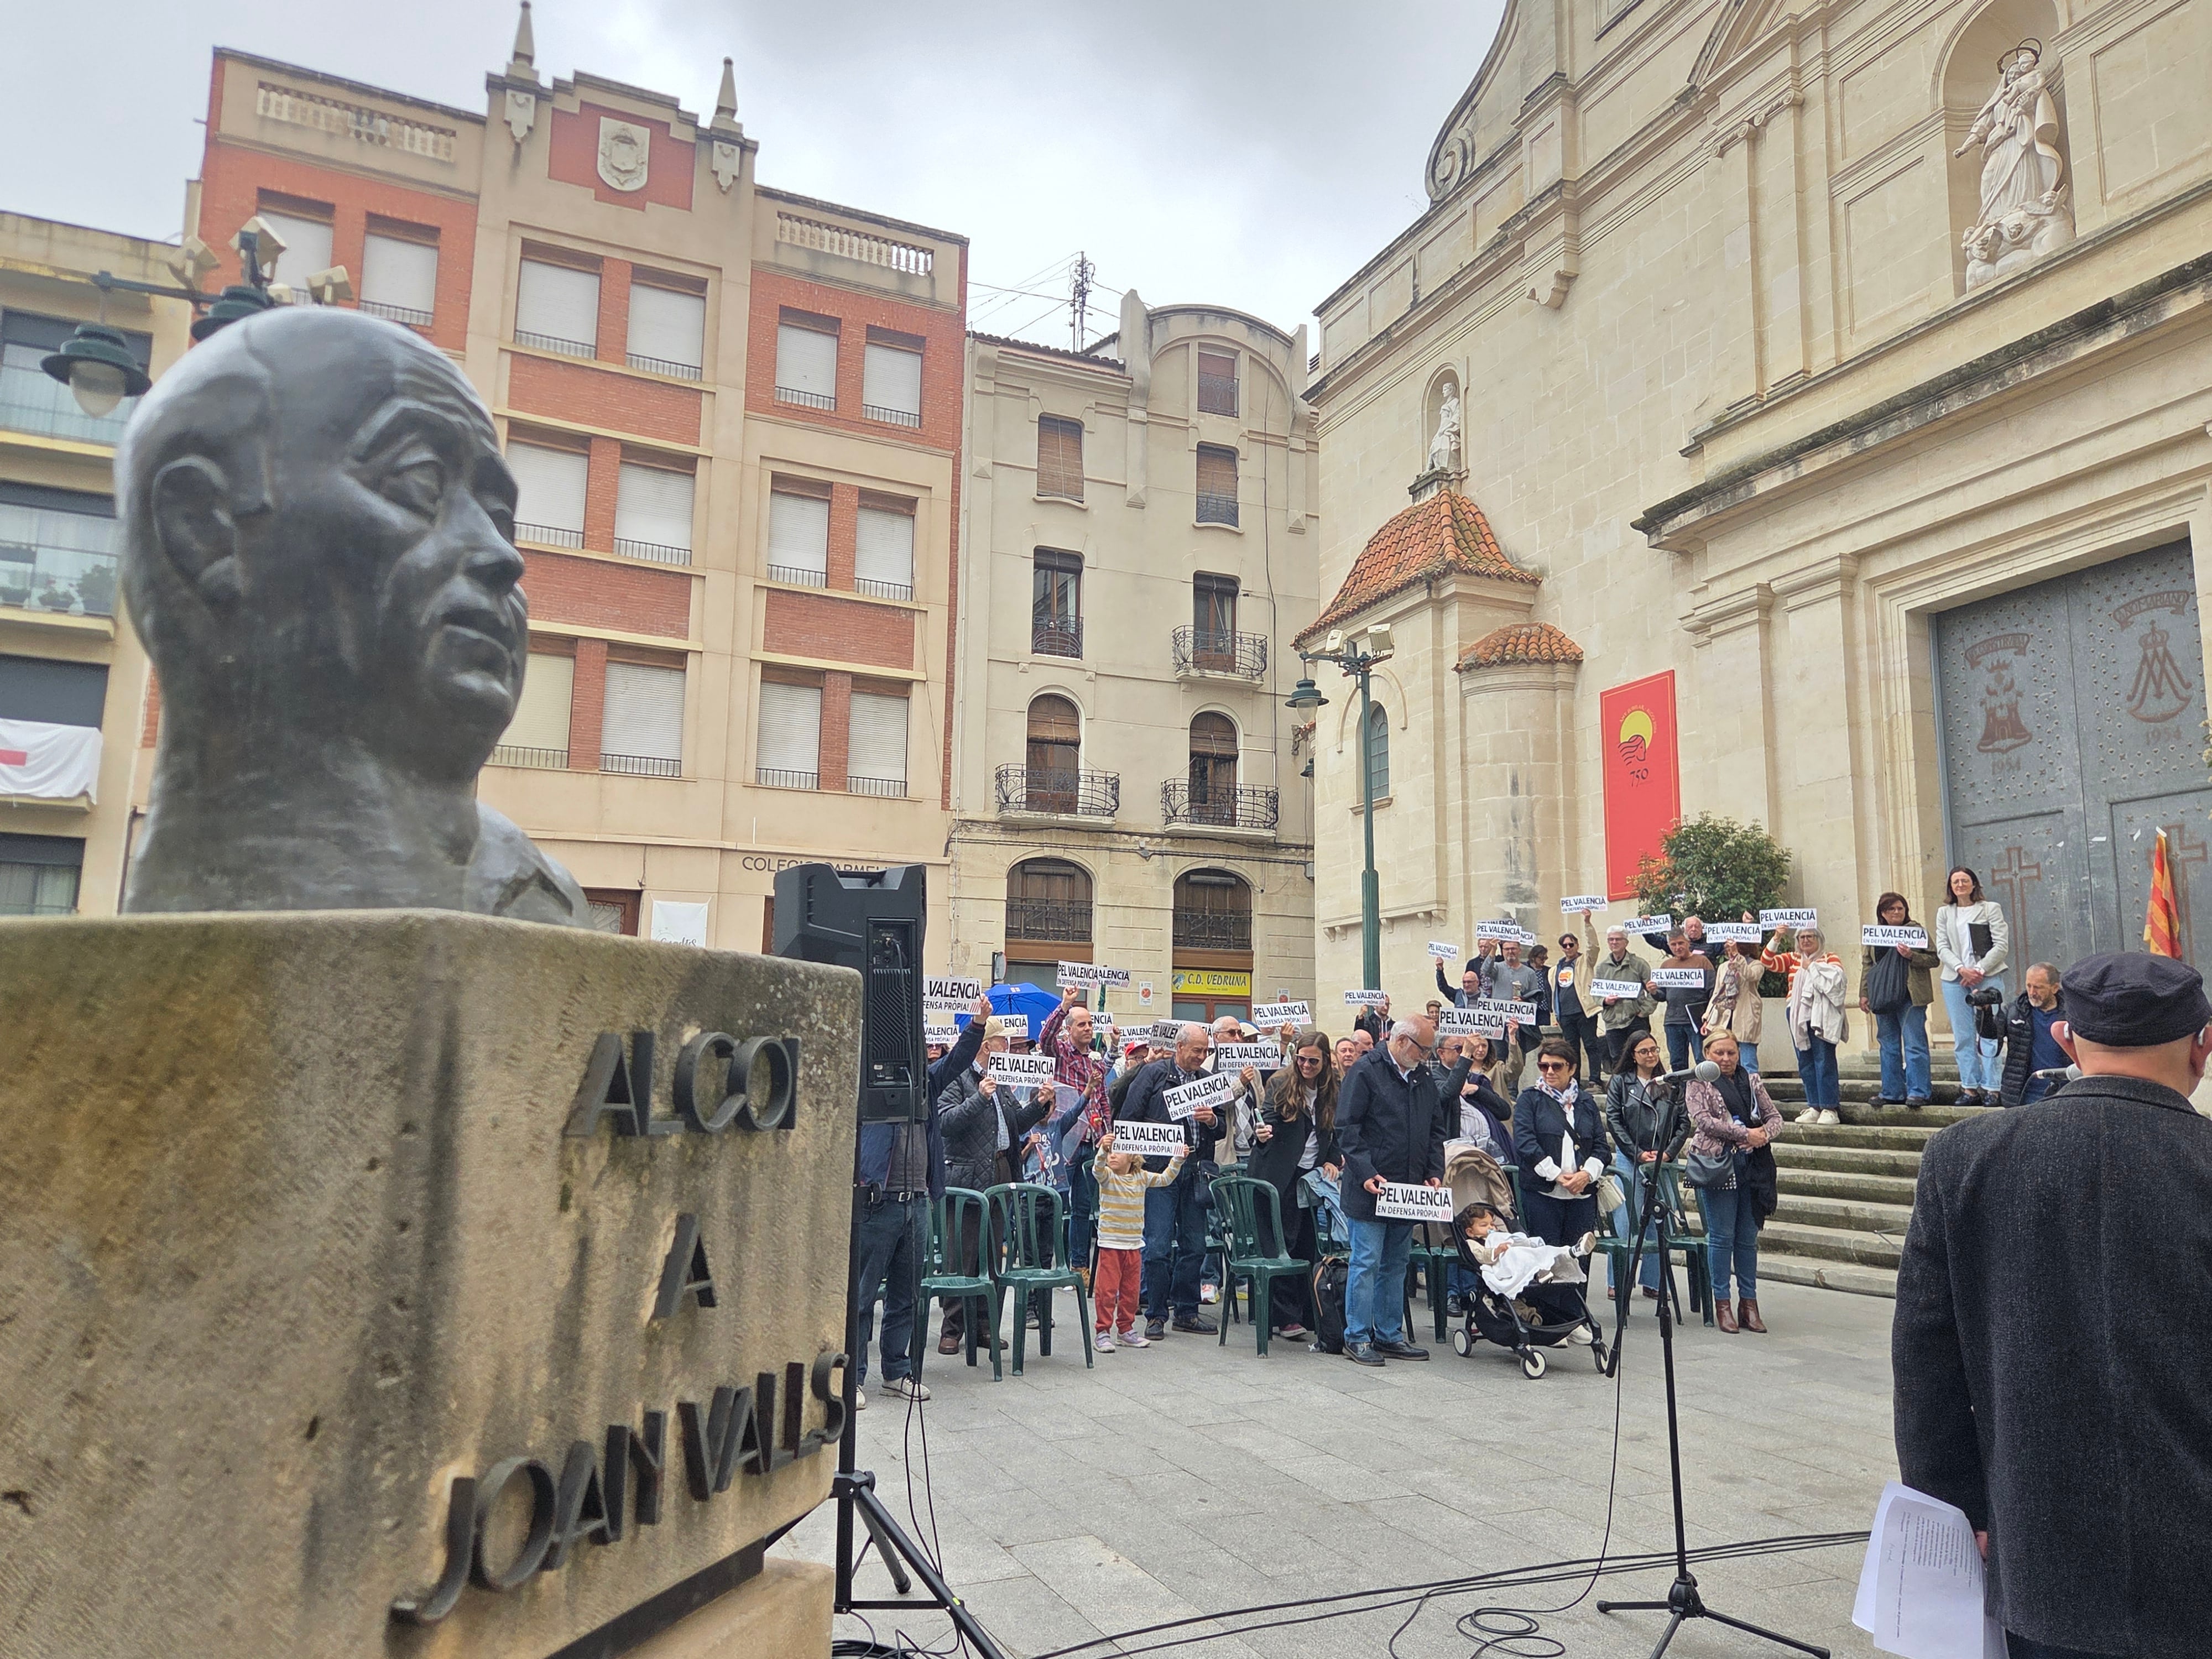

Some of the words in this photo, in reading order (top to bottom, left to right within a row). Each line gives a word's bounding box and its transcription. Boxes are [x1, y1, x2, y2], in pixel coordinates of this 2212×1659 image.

[1573, 896, 1606, 905] VALENCIÀ
[1637, 915, 1670, 927] VALENCIÀ
[1760, 912, 1773, 922] PEL
[1774, 910, 1815, 921] VALENCIÀ
[1489, 926, 1520, 935] VALENCIÀ
[1708, 926, 1720, 935] PEL
[1721, 925, 1760, 935] VALENCIÀ
[1864, 928, 1879, 937] PEL
[1881, 928, 1927, 940] VALENCIÀ
[1057, 964, 1067, 977] PEL
[1068, 966, 1098, 980] VALENCIÀ
[1099, 969, 1130, 981] ALENCIÀ
[1652, 971, 1664, 979] PEL
[1665, 969, 1703, 979] VALENCIÀ
[1187, 973, 1203, 985] C.D.
[1207, 974, 1246, 986] VEDRUNA
[929, 980, 980, 999] VALENCIÀ
[1357, 992, 1385, 1000] VALENCIÀ
[923, 1000, 942, 1010] FENSA
[944, 1000, 969, 1011] PRÒPIA!
[1254, 1008, 1268, 1018] PEL
[1267, 1003, 1308, 1017] VALENCIÀ
[1478, 1001, 1492, 1011] PEL
[1494, 1002, 1535, 1015] VALENCIÀ
[1002, 1016, 1027, 1027] ENCIÀ
[1091, 1014, 1113, 1024] ENCIÀ
[1440, 1011, 1457, 1024] PEL
[1458, 1012, 1504, 1028] VALENCIÀ
[925, 1026, 958, 1036] VALENCIÀ
[1128, 1027, 1151, 1036] VALENC
[1219, 1047, 1236, 1059] PEL
[1237, 1045, 1280, 1059] VALENCIÀ
[989, 1056, 1008, 1072] PEL
[1008, 1057, 1054, 1076] VALENCIÀ
[564, 1031, 801, 1138] ALCOI
[998, 1074, 1023, 1084] DEFENSA
[1165, 1091, 1186, 1108] PEL
[1183, 1074, 1230, 1101] VALENCIÀ
[1205, 1094, 1224, 1106] PRÒPIA!
[1114, 1125, 1131, 1140] PEL
[1132, 1126, 1183, 1143] VALENCIÀ
[1113, 1142, 1121, 1151] EN
[1121, 1143, 1148, 1152] DEFENSA
[1149, 1143, 1173, 1154] PRÒPIA!
[1378, 1186, 1399, 1203] PEL
[1401, 1188, 1451, 1208] VALENCIÀ
[1377, 1205, 1386, 1213] EN
[1387, 1206, 1416, 1217] DEFENSA
[1417, 1207, 1439, 1218] PRÒPIA!
[653, 1214, 718, 1319] A
[385, 1409, 664, 1623] JOAN
[678, 1351, 849, 1503] VALLS
